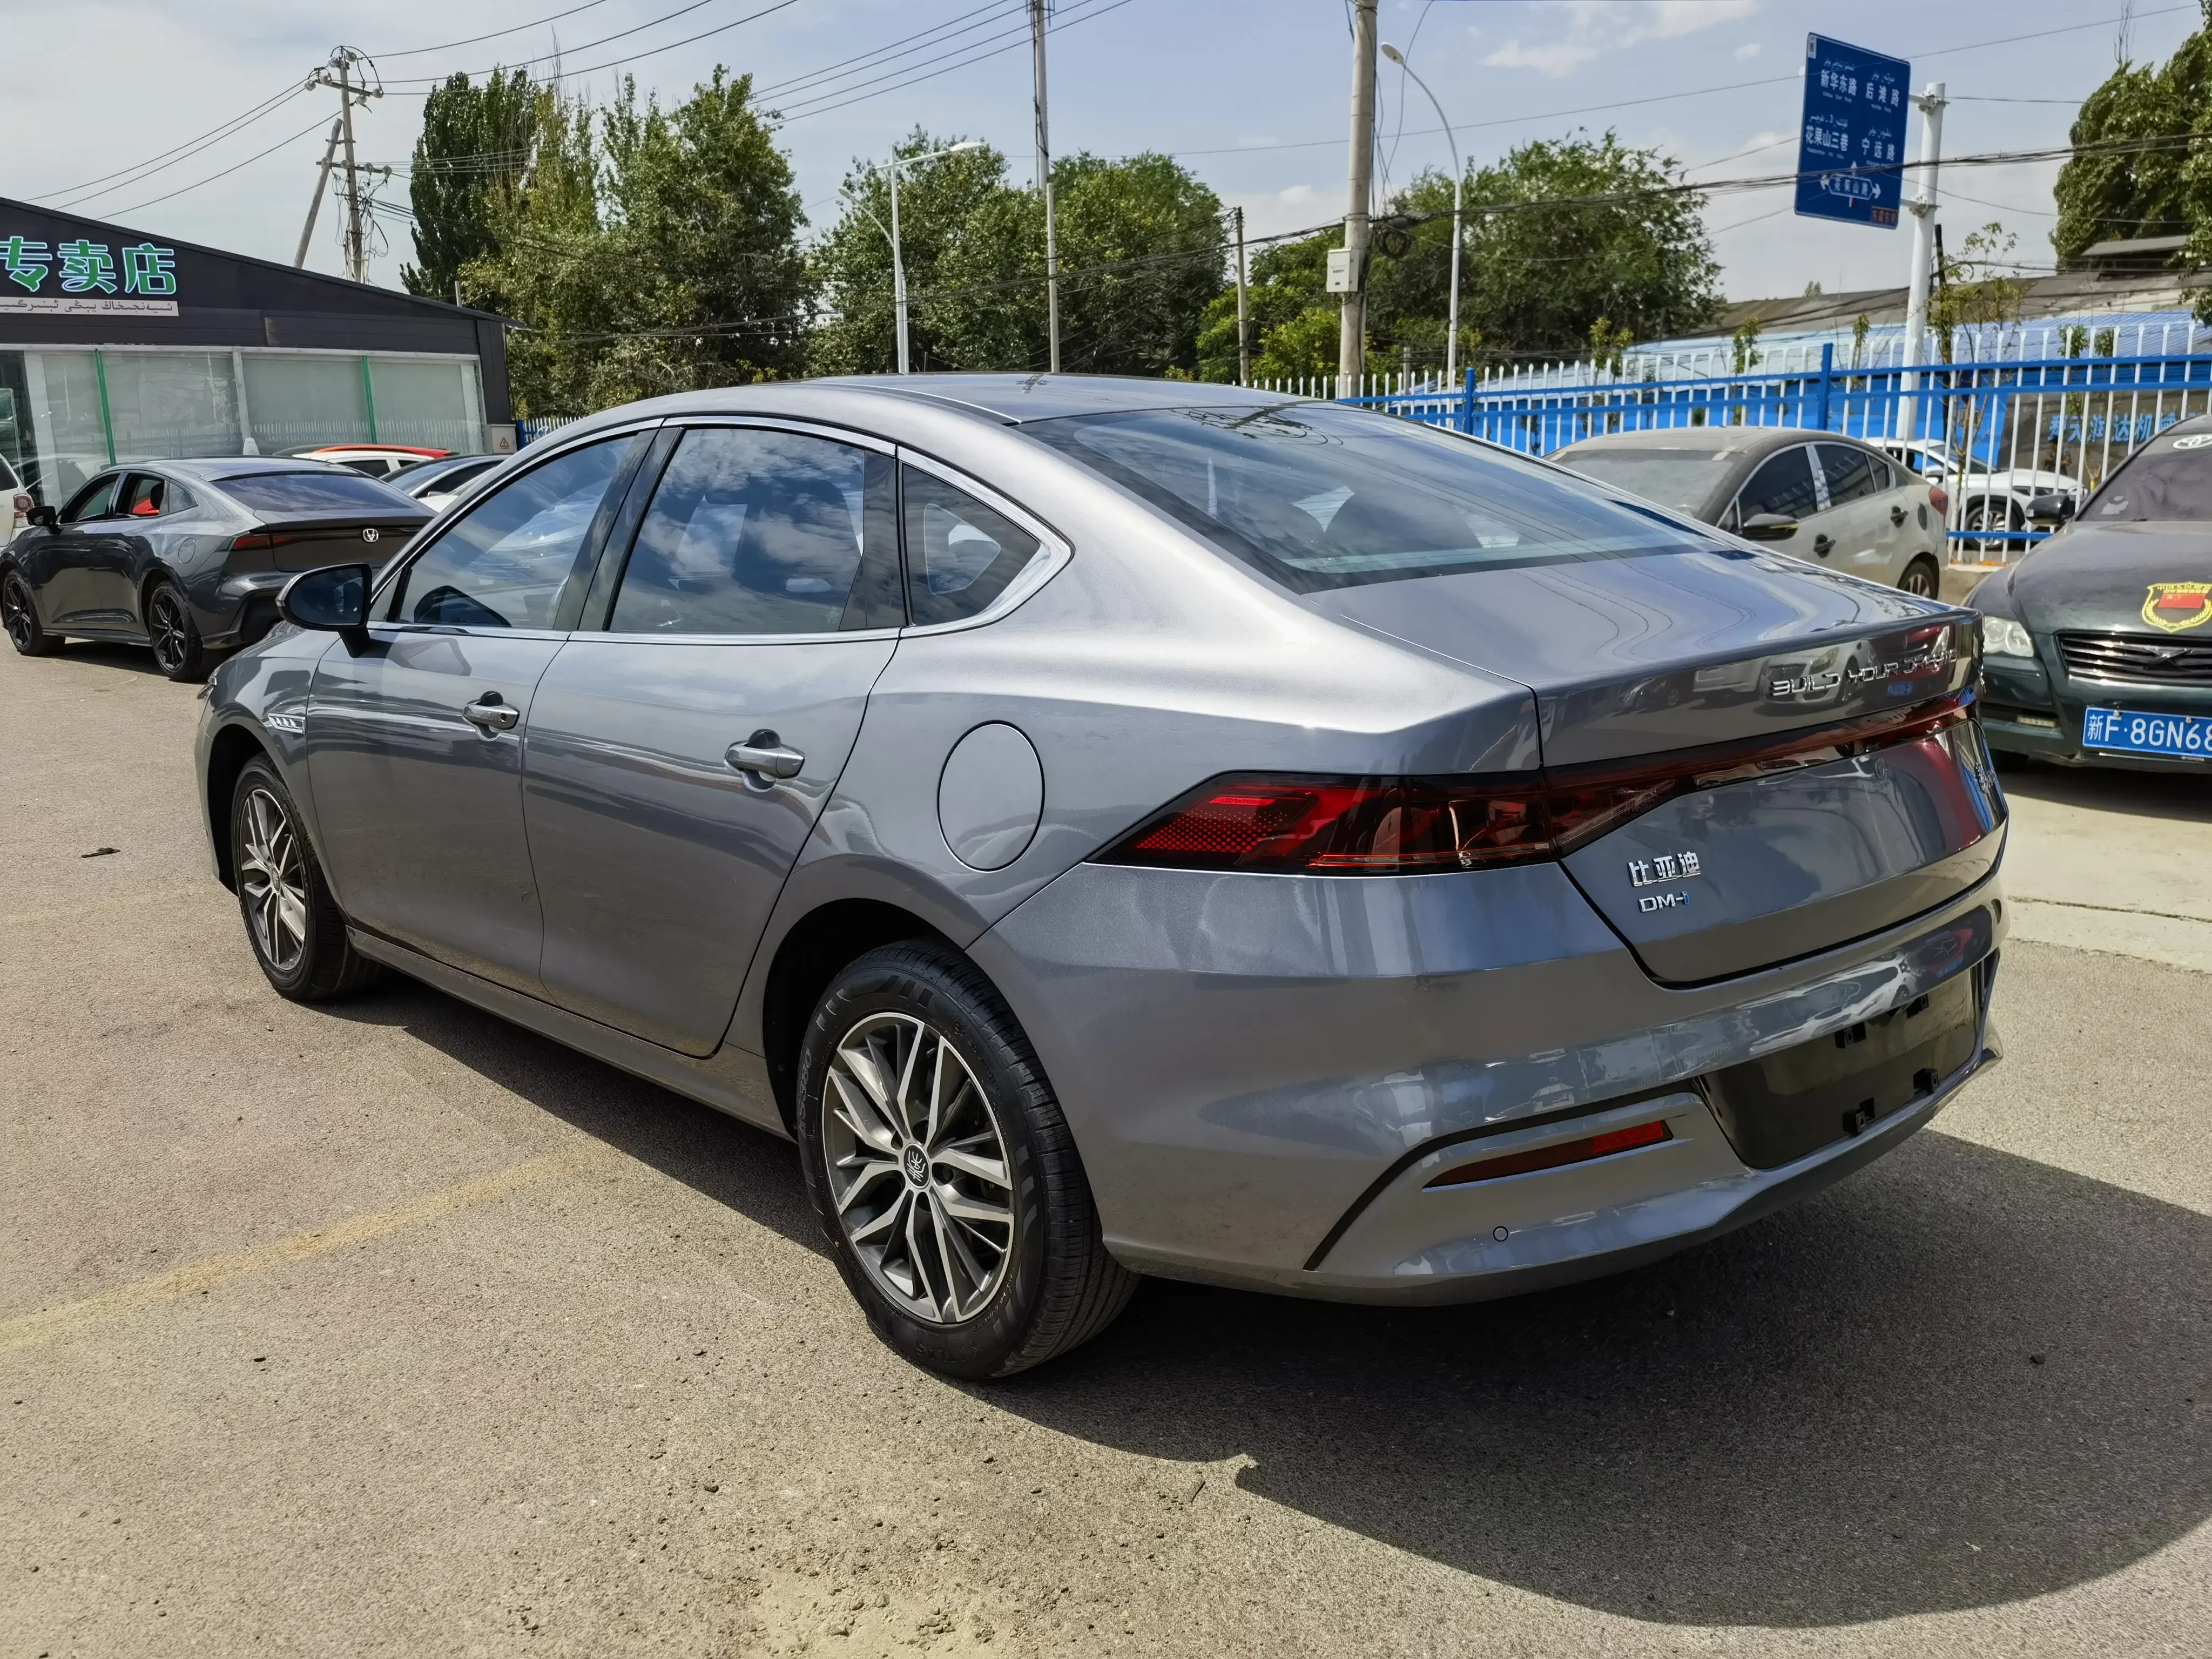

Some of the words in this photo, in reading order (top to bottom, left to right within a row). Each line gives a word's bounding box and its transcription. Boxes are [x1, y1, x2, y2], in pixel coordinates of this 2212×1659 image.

[0, 236, 177, 295] 专卖店
[1770, 673, 1840, 696] BUILD
[1846, 663, 1899, 684] YOUR
[1627, 851, 1701, 887] 比亚迪
[1637, 891, 1690, 913] DM-i
